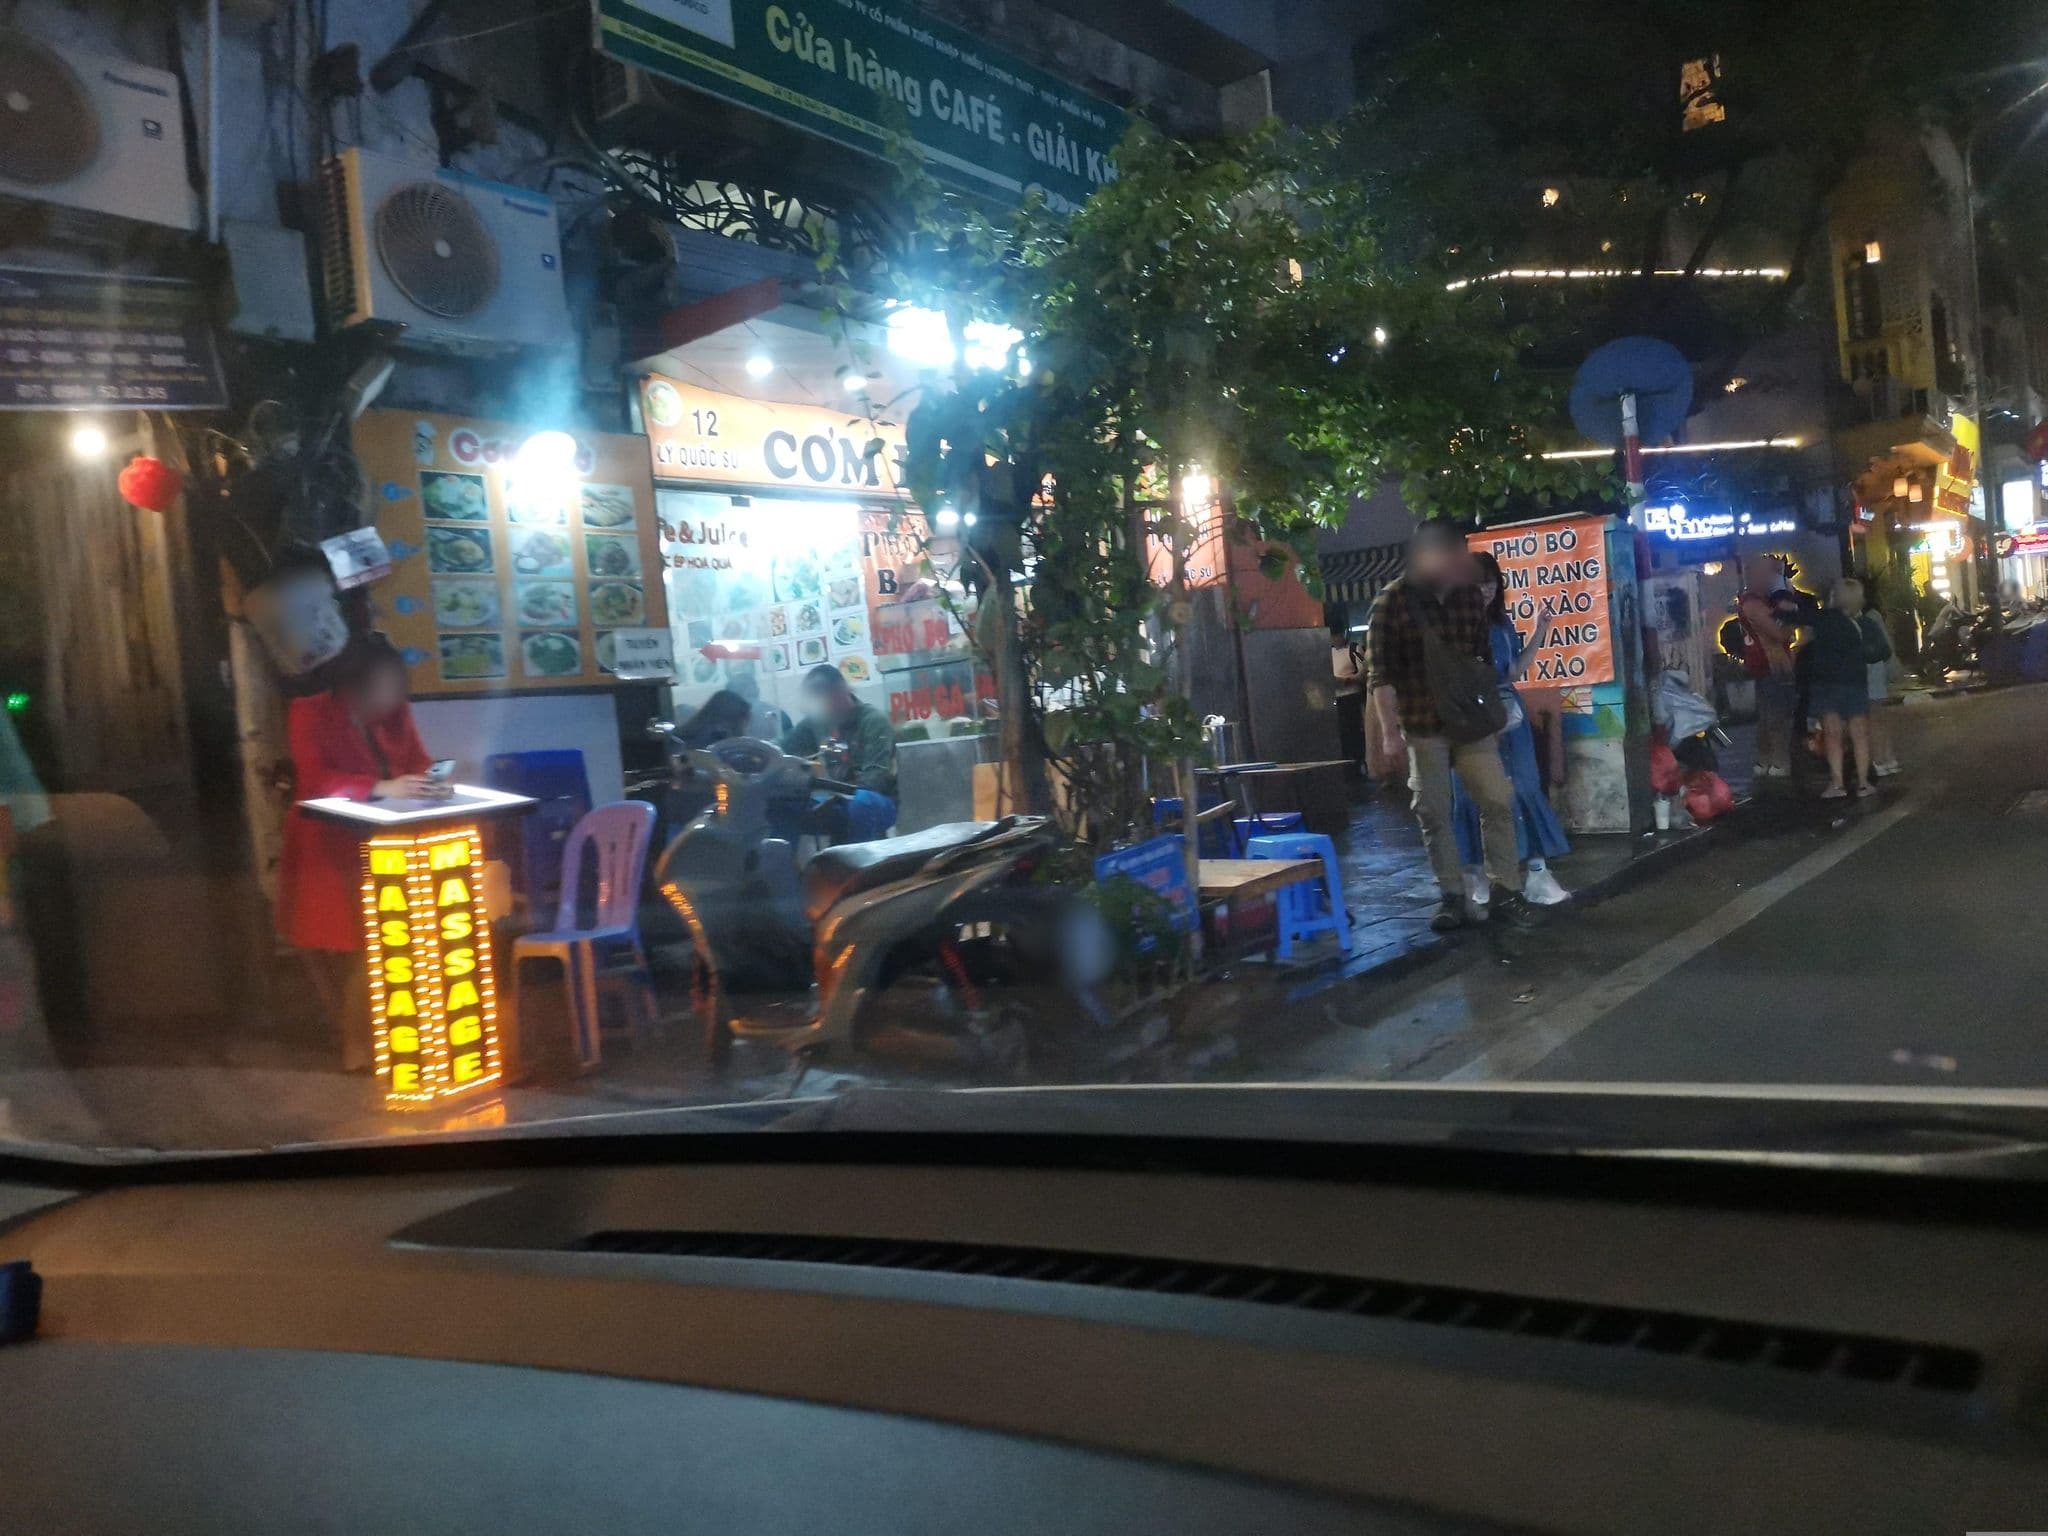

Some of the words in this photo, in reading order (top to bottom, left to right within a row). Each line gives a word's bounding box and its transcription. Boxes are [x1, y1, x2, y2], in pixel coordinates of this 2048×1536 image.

[766, 5, 836, 73] Cửa
[844, 39, 922, 118] hàng
[929, 78, 1005, 144] CAFÉ
[1027, 121, 1080, 176] GIẢI
[1085, 146, 1118, 184] KH
[692, 409, 719, 437] 12
[764, 427, 880, 487] CƠM
[1493, 532, 1538, 561] PHỞ
[1546, 527, 1577, 553] BÒ
[1501, 566, 1529, 591] ƠM
[1537, 559, 1600, 586] RANG
[1504, 592, 1535, 621] HỞ
[1542, 590, 1592, 616] XÀO
[1540, 623, 1599, 649] ANG
[1537, 654, 1586, 680] XÀO
